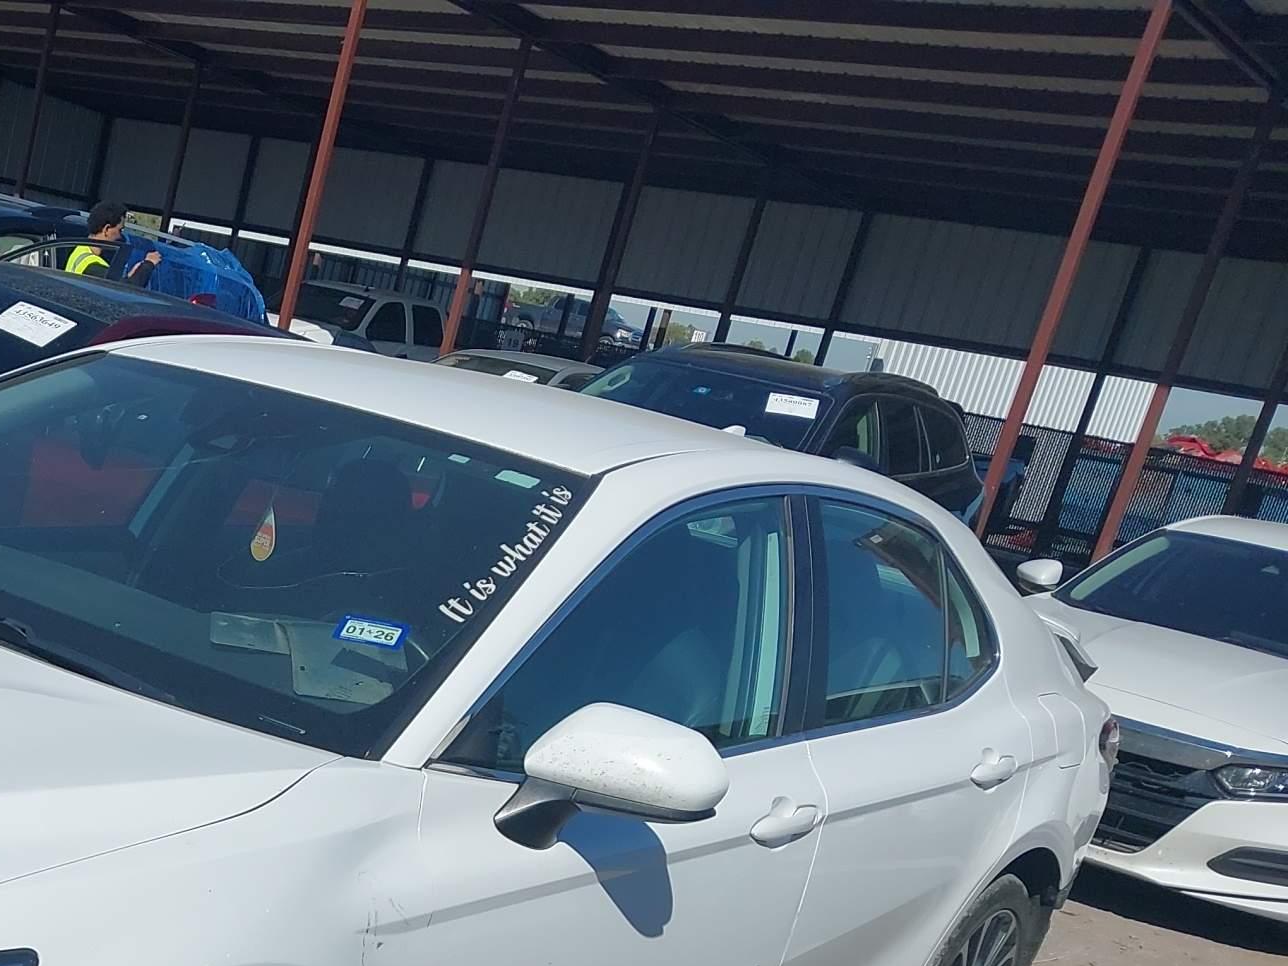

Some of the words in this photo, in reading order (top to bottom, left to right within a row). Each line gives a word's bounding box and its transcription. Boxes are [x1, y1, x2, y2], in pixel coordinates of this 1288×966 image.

[542, 484, 573, 505] is
[532, 504, 563, 526] it
[491, 521, 550, 577] what
[463, 577, 497, 601] is
[439, 598, 474, 623] It
[374, 630, 395, 641] 26
